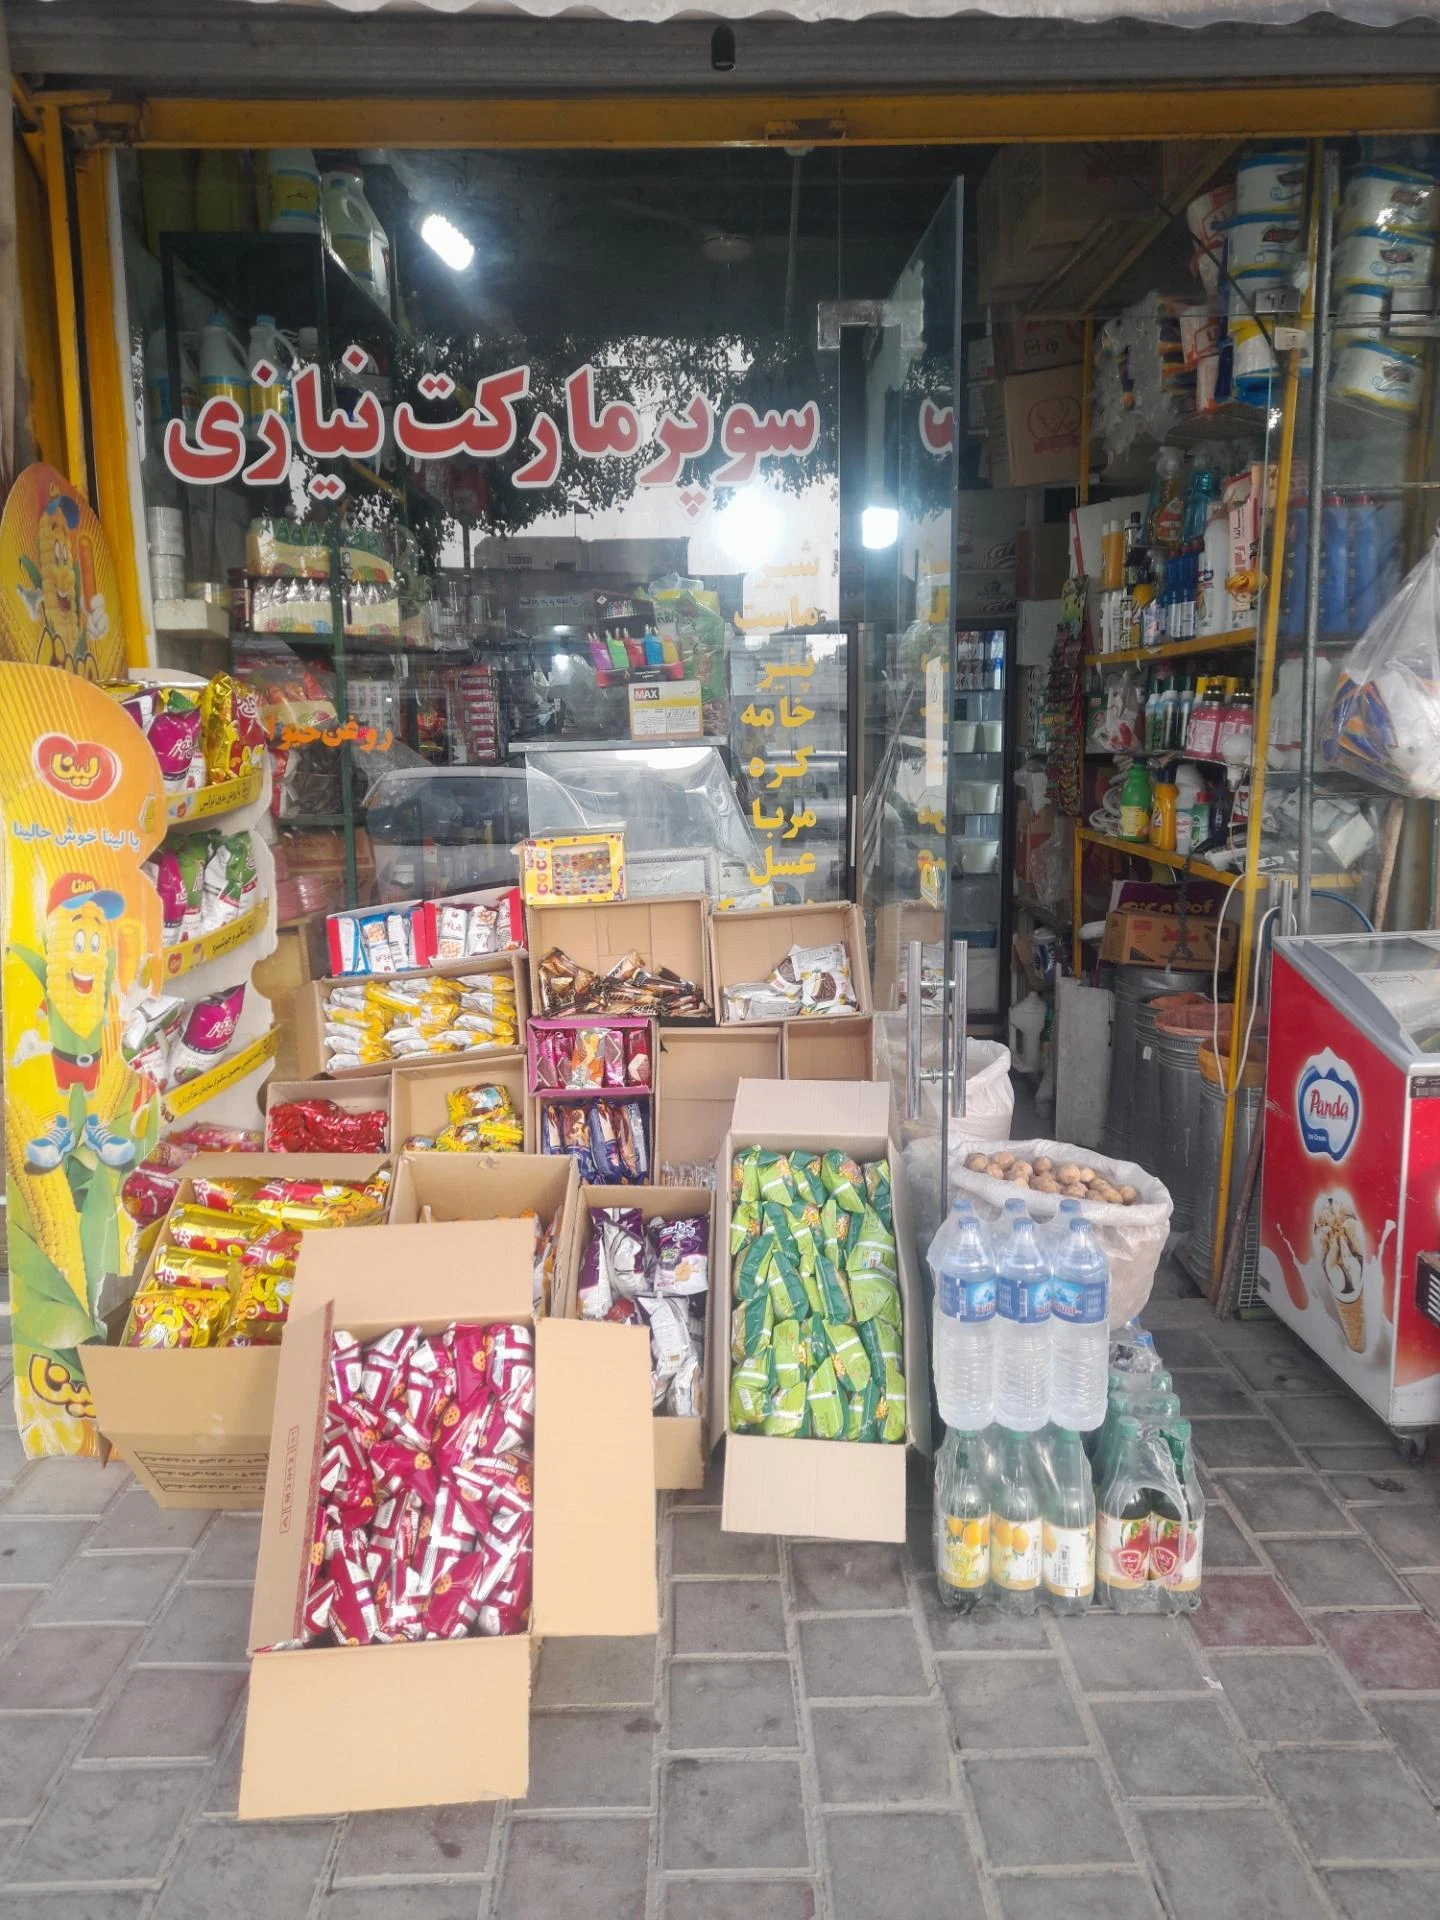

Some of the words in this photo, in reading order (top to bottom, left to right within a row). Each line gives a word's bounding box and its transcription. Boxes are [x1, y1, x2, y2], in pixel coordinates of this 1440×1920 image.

[164, 345, 384, 499] نیازی
[755, 541, 819, 591] شیر
[734, 593, 819, 630] ماست
[757, 648, 816, 692] پنیر
[634, 688, 659, 700] MAX
[740, 696, 816, 728] خامه
[322, 713, 393, 752] روغن
[52, 753, 100, 787] لینا
[749, 745, 815, 788] کره
[13, 821, 52, 841] حالینا
[752, 798, 817, 839] مربا
[102, 830, 125, 849] لینا
[129, 832, 140, 851] با
[750, 845, 816, 886] عسل
[1309, 1089, 1349, 1118] Panda
[29, 1353, 97, 1418] ینا
